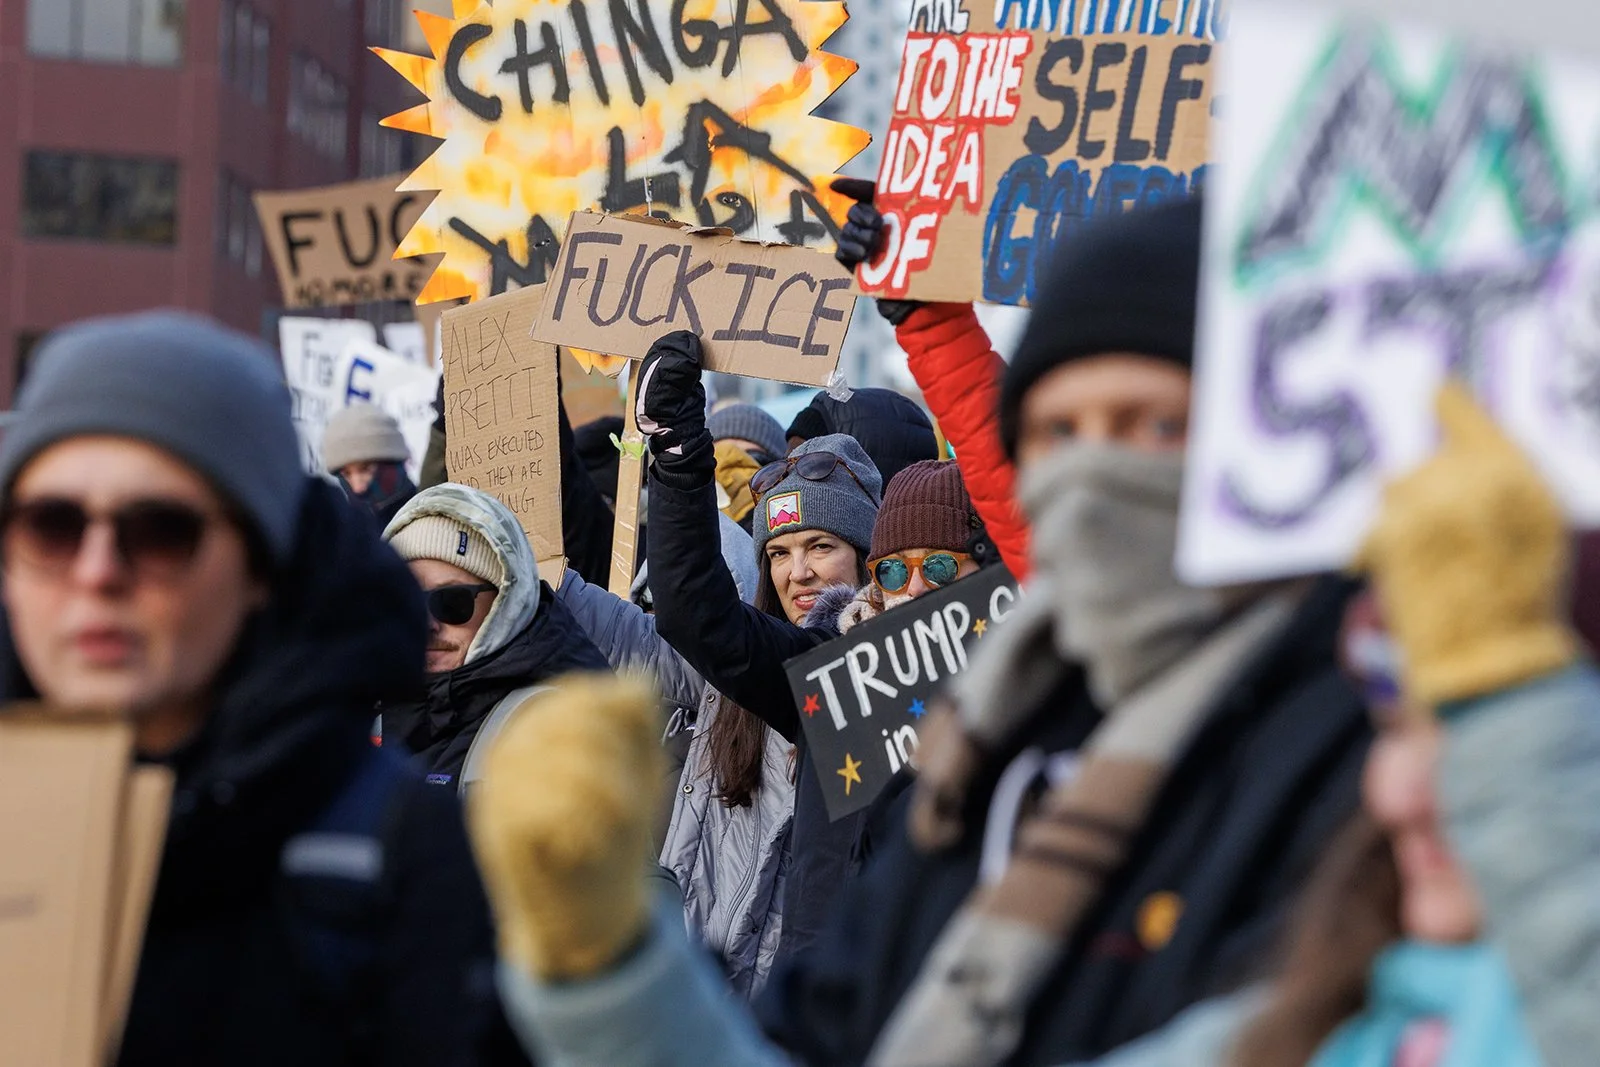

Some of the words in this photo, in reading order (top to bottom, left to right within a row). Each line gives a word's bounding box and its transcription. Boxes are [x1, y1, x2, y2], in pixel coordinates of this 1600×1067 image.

[444, 0, 810, 121] CHINGA
[895, 36, 961, 121] TO
[958, 36, 1030, 119] THE
[600, 98, 815, 212] LA
[878, 123, 982, 204] IDEA
[860, 211, 939, 291] OF
[552, 231, 704, 336] FUCK
[712, 261, 851, 356] ICE
[447, 310, 517, 384] ALEX
[449, 366, 542, 438] PRETTI
[449, 443, 483, 474] WAS
[487, 429, 544, 461] EXECUTED
[486, 464, 516, 488] THEY
[522, 459, 543, 482] ARE
[805, 601, 970, 731] TRUMP
